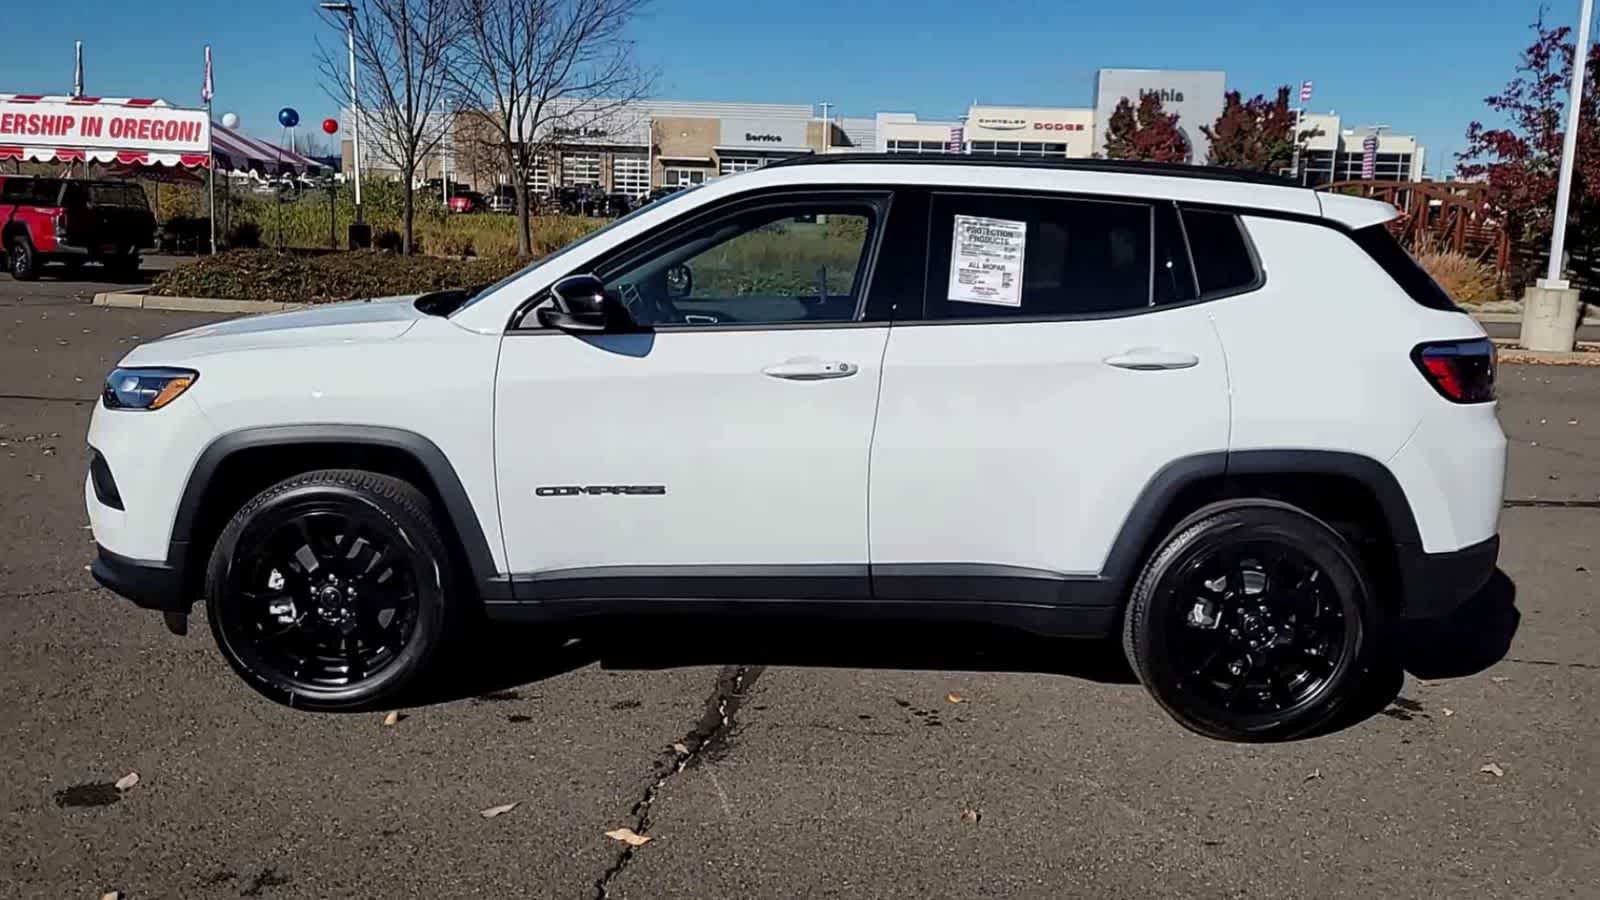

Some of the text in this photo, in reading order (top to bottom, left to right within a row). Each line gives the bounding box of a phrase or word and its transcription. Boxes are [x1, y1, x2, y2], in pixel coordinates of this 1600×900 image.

[0, 113, 202, 142] ERSHIP IN OREGON!
[1033, 122, 1084, 131] DODGE
[745, 132, 782, 143] Service
[966, 226, 1014, 238] PROTECTION
[969, 234, 1010, 246] PRODUCTS
[982, 263, 1006, 272] MOPAR
[535, 485, 666, 497] COMPASS
